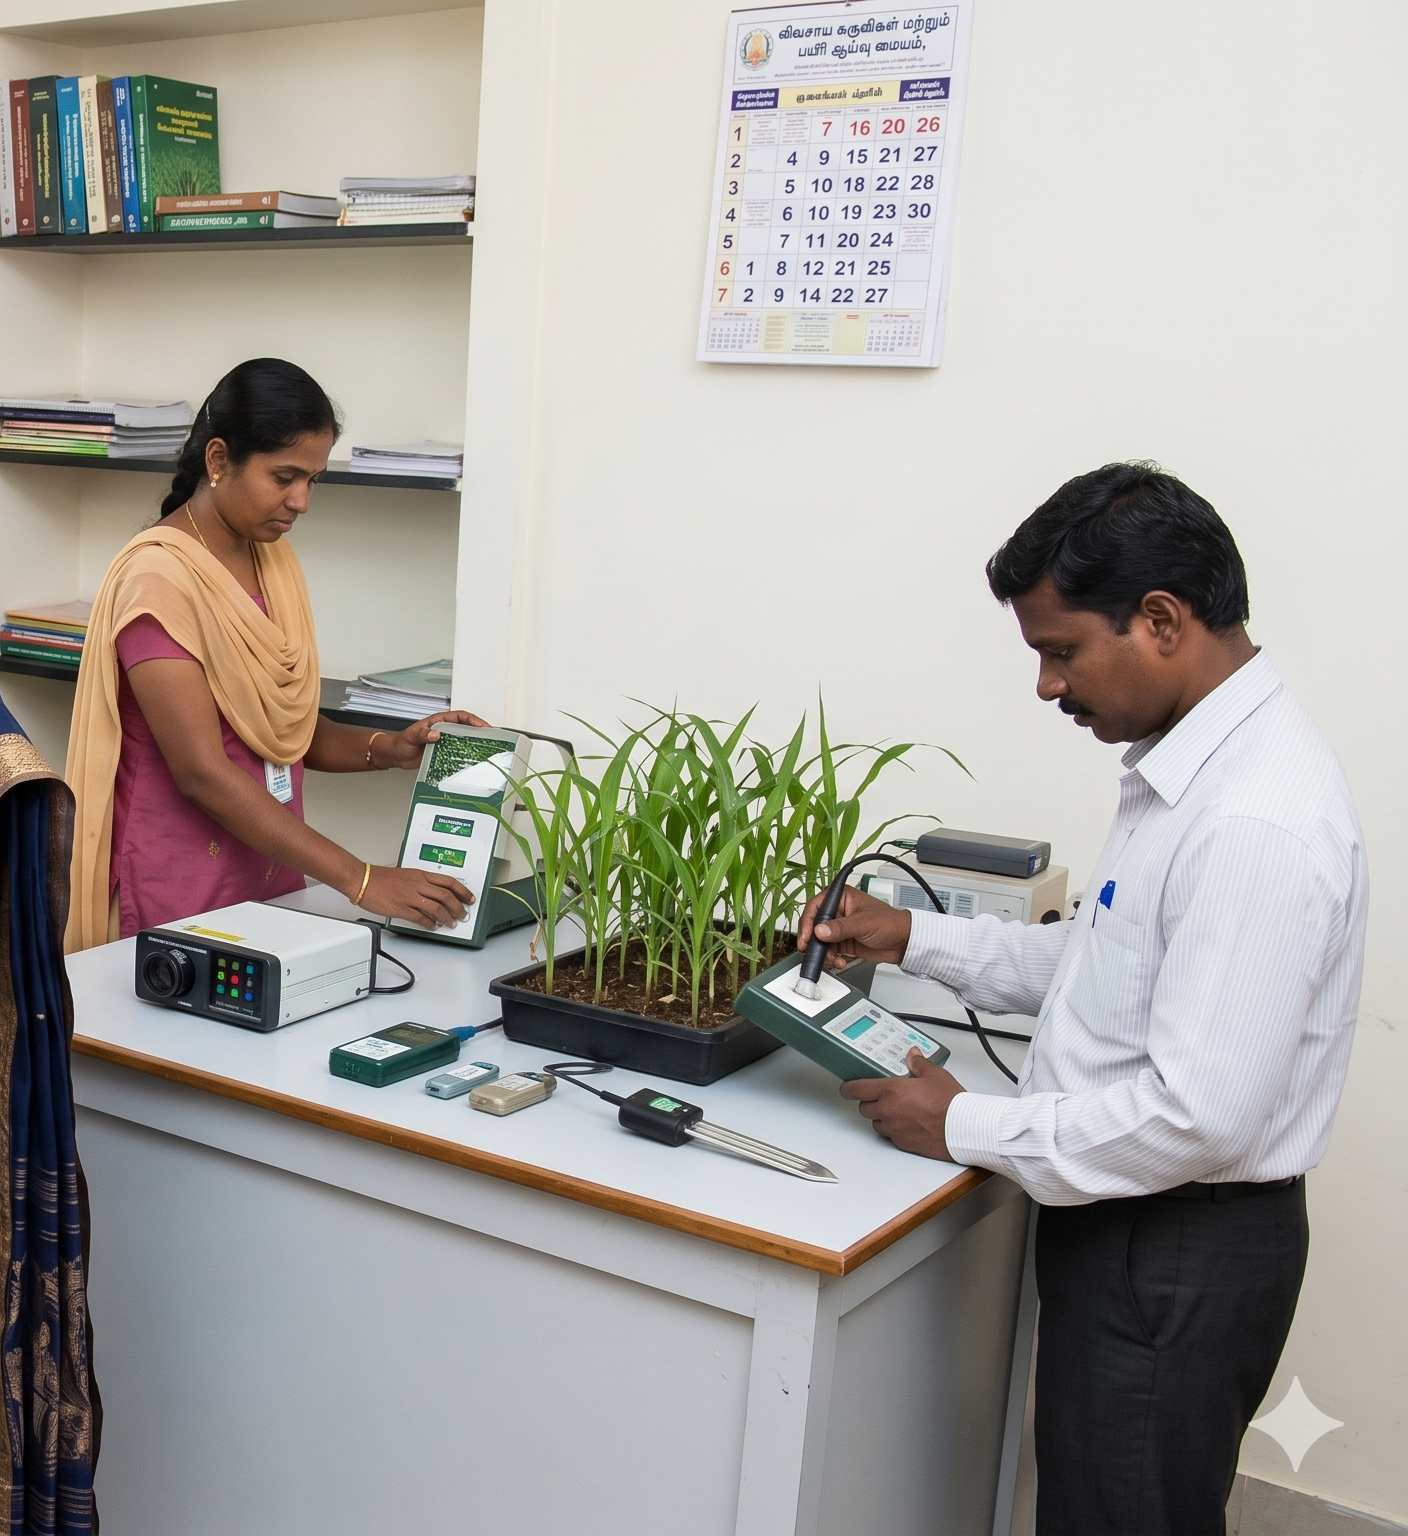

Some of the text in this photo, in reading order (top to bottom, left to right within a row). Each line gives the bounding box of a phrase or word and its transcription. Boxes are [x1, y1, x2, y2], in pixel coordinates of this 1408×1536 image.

[734, 126, 742, 142] 1
[822, 121, 833, 137] 7
[850, 120, 871, 136] 16
[881, 118, 906, 135] 20
[916, 116, 940, 133] 26
[730, 145, 938, 169] 2 4 9 15 21 27
[728, 174, 934, 196] 3 5 10 18 22 28
[725, 207, 736, 223] 4
[782, 206, 793, 222] 6
[808, 205, 830, 221] 10
[841, 204, 862, 220] 19
[872, 203, 897, 220] 23
[907, 202, 932, 219] 30
[722, 234, 733, 249] 5
[780, 233, 790, 249] 7
[805, 233, 825, 249] 11
[836, 232, 860, 248] 20
[869, 231, 894, 248] 24
[720, 260, 891, 276] 6 1 8 12 21 25
[718, 287, 889, 303] 7 2 9 14 22 27
